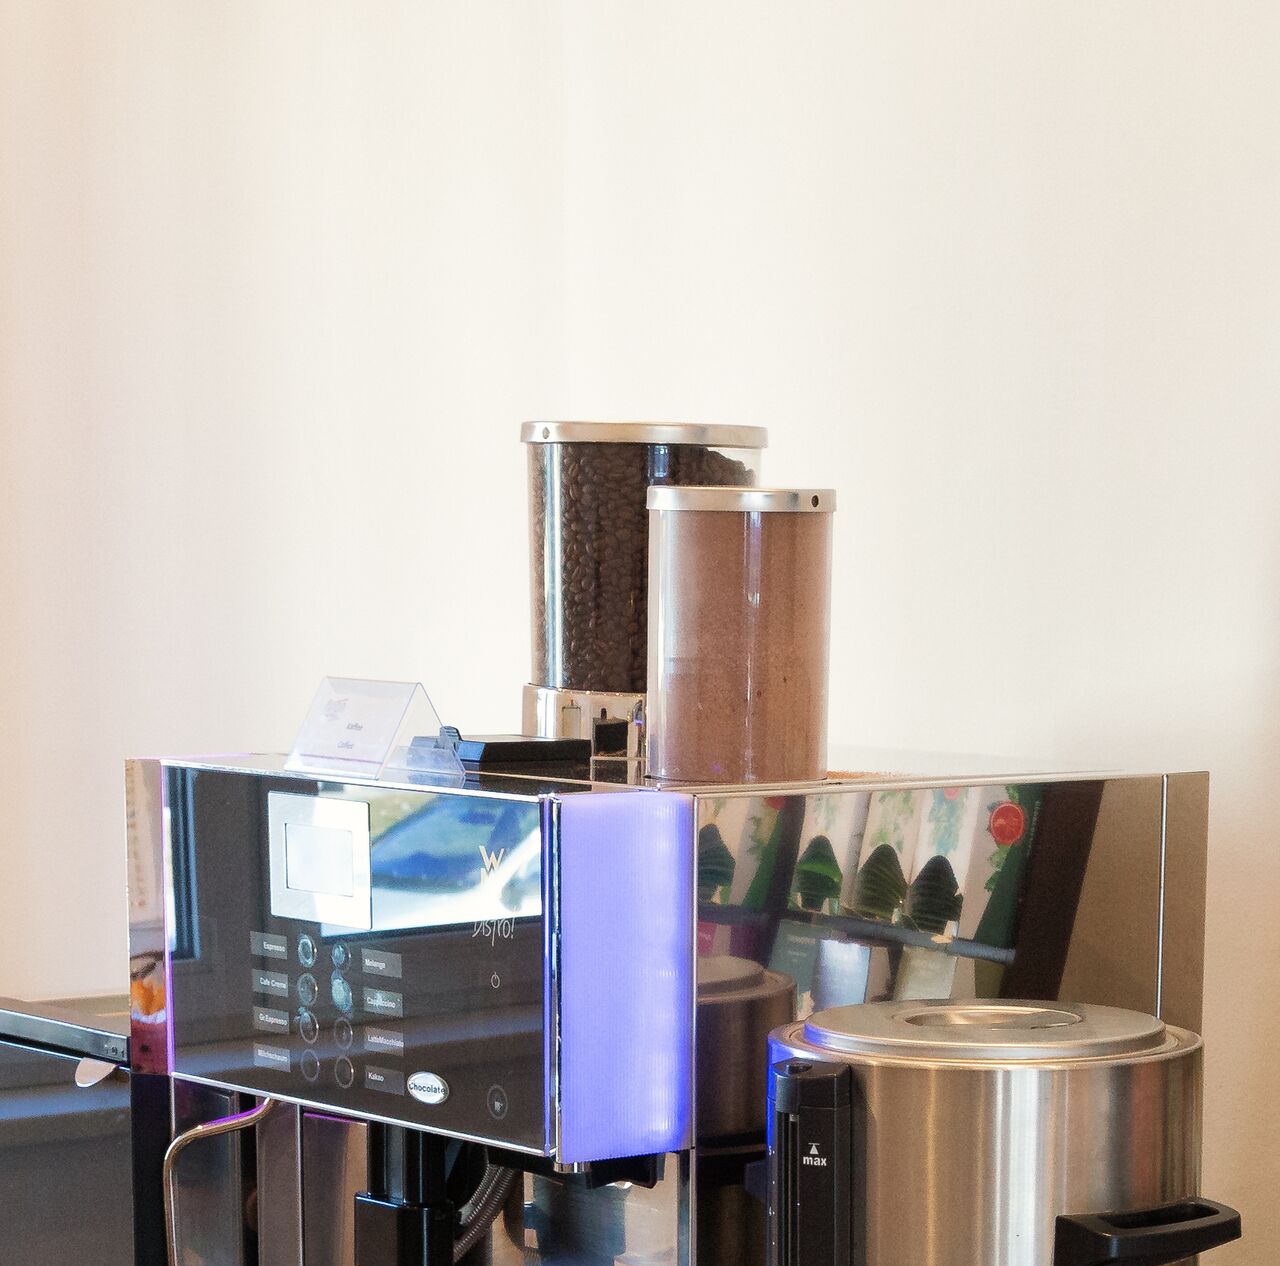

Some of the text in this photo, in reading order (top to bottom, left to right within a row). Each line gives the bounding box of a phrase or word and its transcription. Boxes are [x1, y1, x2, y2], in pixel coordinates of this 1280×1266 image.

[369, 1073, 384, 1081] Kakao
[409, 1083, 446, 1095] Chocolate
[803, 1156, 826, 1166] max
